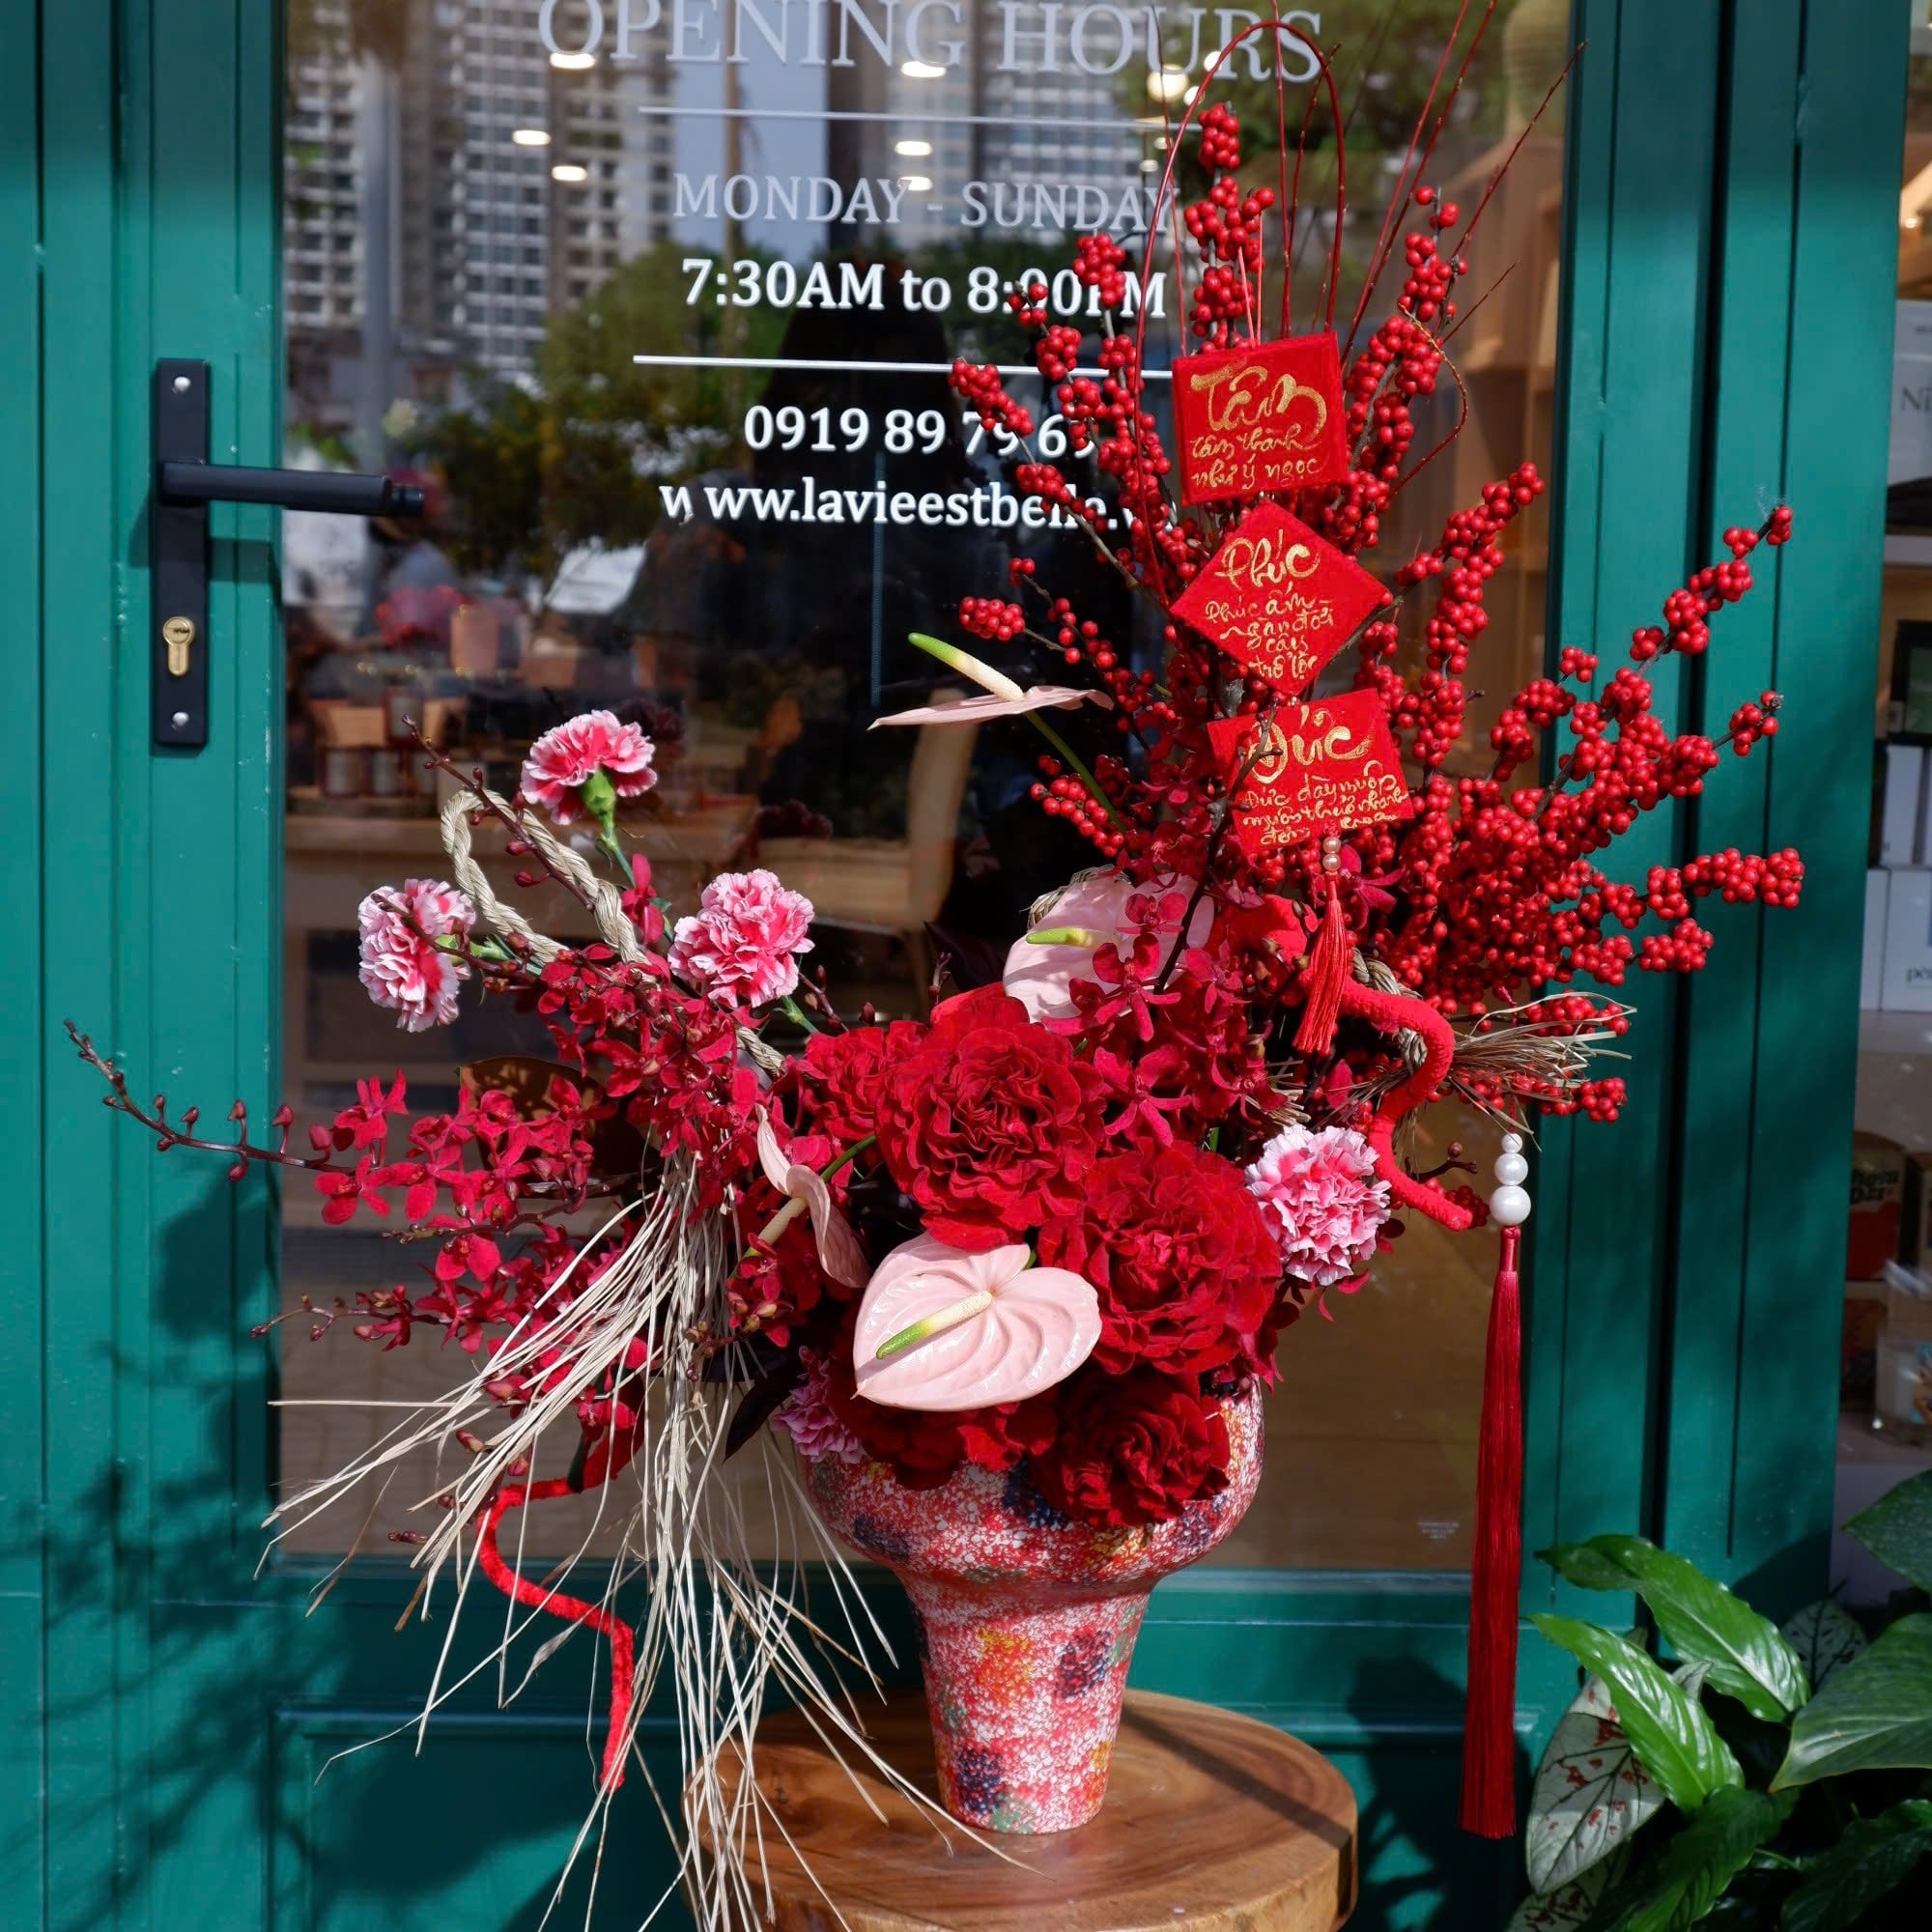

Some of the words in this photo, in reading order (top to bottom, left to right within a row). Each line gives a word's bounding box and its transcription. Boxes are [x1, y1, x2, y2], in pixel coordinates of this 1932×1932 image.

[538, 0, 966, 68] OPENING
[997, 2, 1321, 82] HOURS
[673, 173, 913, 223] MONDAY
[960, 182, 1179, 232] SUNDAY
[682, 259, 886, 310] 7:30AM
[900, 270, 952, 312] to
[967, 267, 1167, 318] 8:0M
[744, 406, 869, 452] 0919
[884, 410, 946, 455] 89
[1037, 413, 1095, 459] 6
